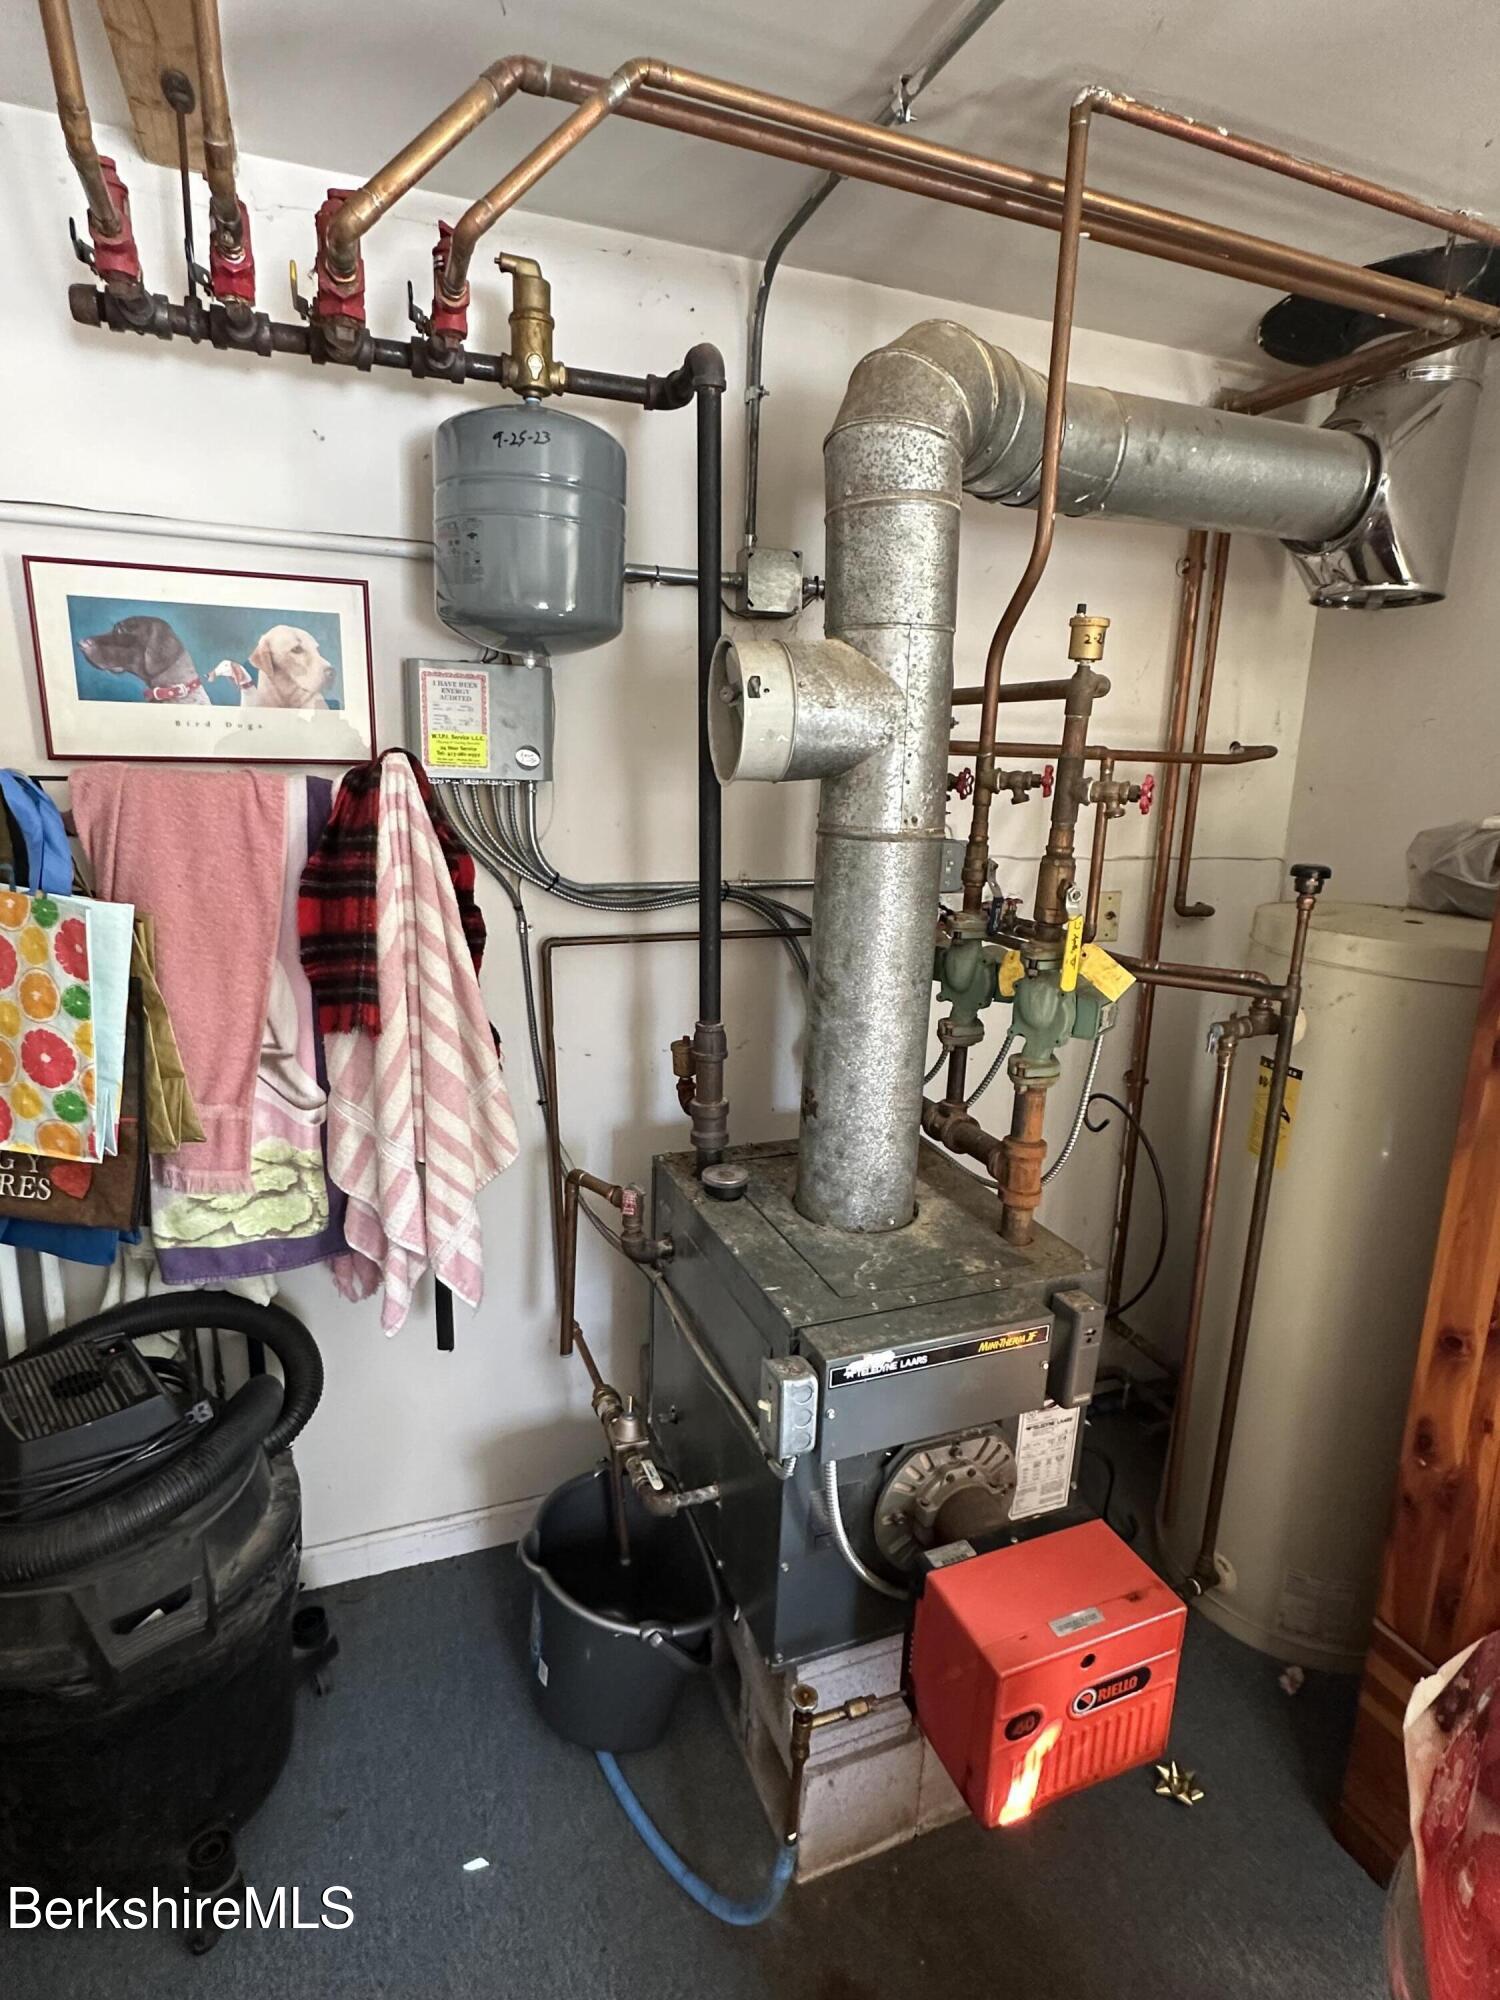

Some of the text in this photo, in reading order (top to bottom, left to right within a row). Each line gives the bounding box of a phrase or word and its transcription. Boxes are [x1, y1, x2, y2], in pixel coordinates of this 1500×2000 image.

[492, 430, 551, 448] 9-25-23
[437, 680, 457, 688] HAVE
[458, 681, 478, 689] BEEN
[441, 687, 470, 695] ENERGY
[440, 694, 472, 702] AUDITED
[175, 720, 263, 731] Bird Dogs
[450, 733, 470, 741] Service
[900, 1355, 928, 1369] LAARS
[1098, 1676, 1138, 1702] RIELLO
